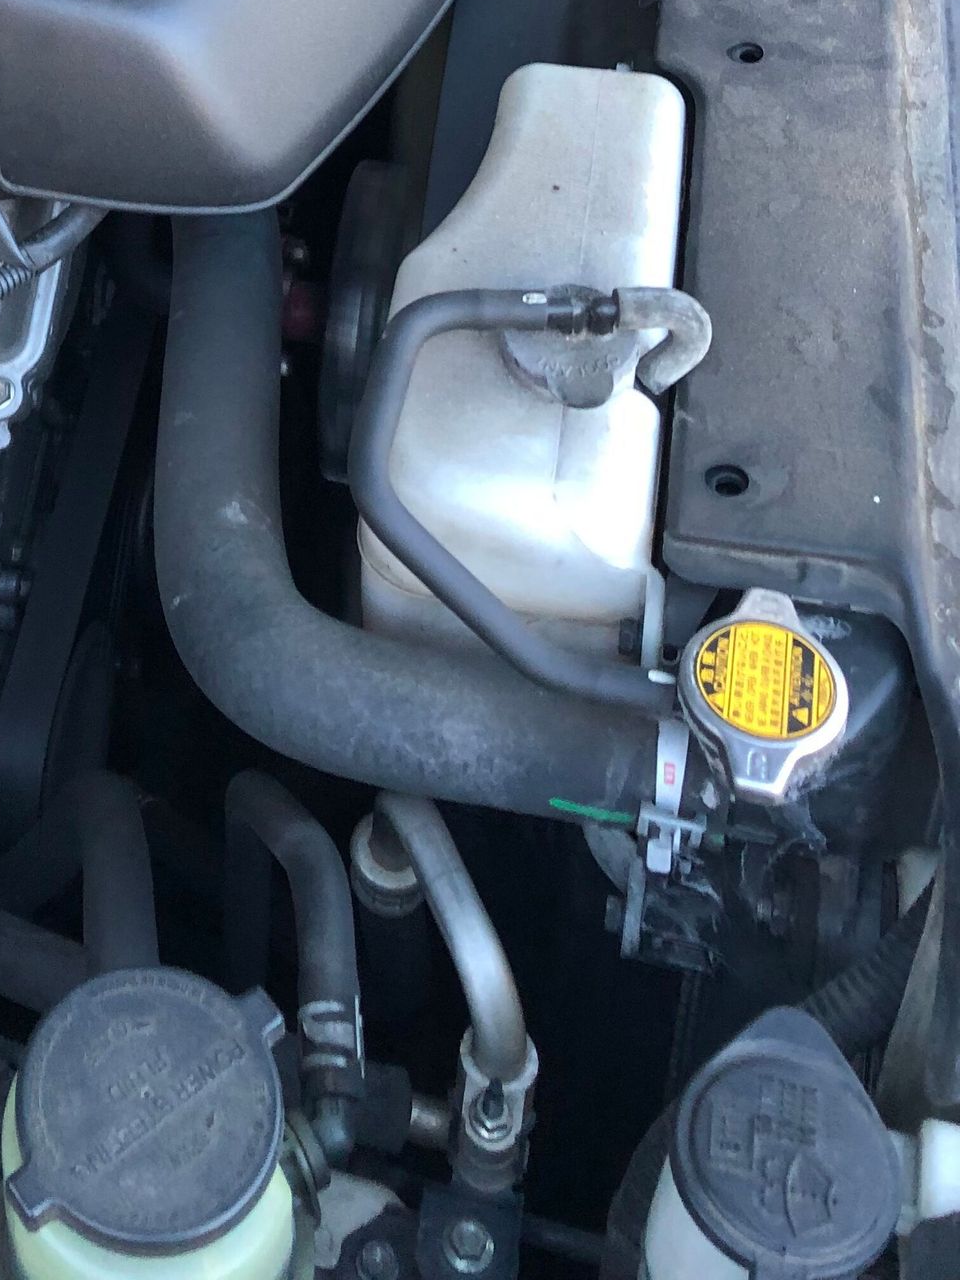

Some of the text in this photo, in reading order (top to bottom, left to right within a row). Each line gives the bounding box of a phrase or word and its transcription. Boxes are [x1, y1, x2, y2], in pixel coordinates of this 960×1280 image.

[107, 1044, 172, 1102] FLUID
[172, 1038, 247, 1099] POWER
[69, 1095, 174, 1178] STEERING
